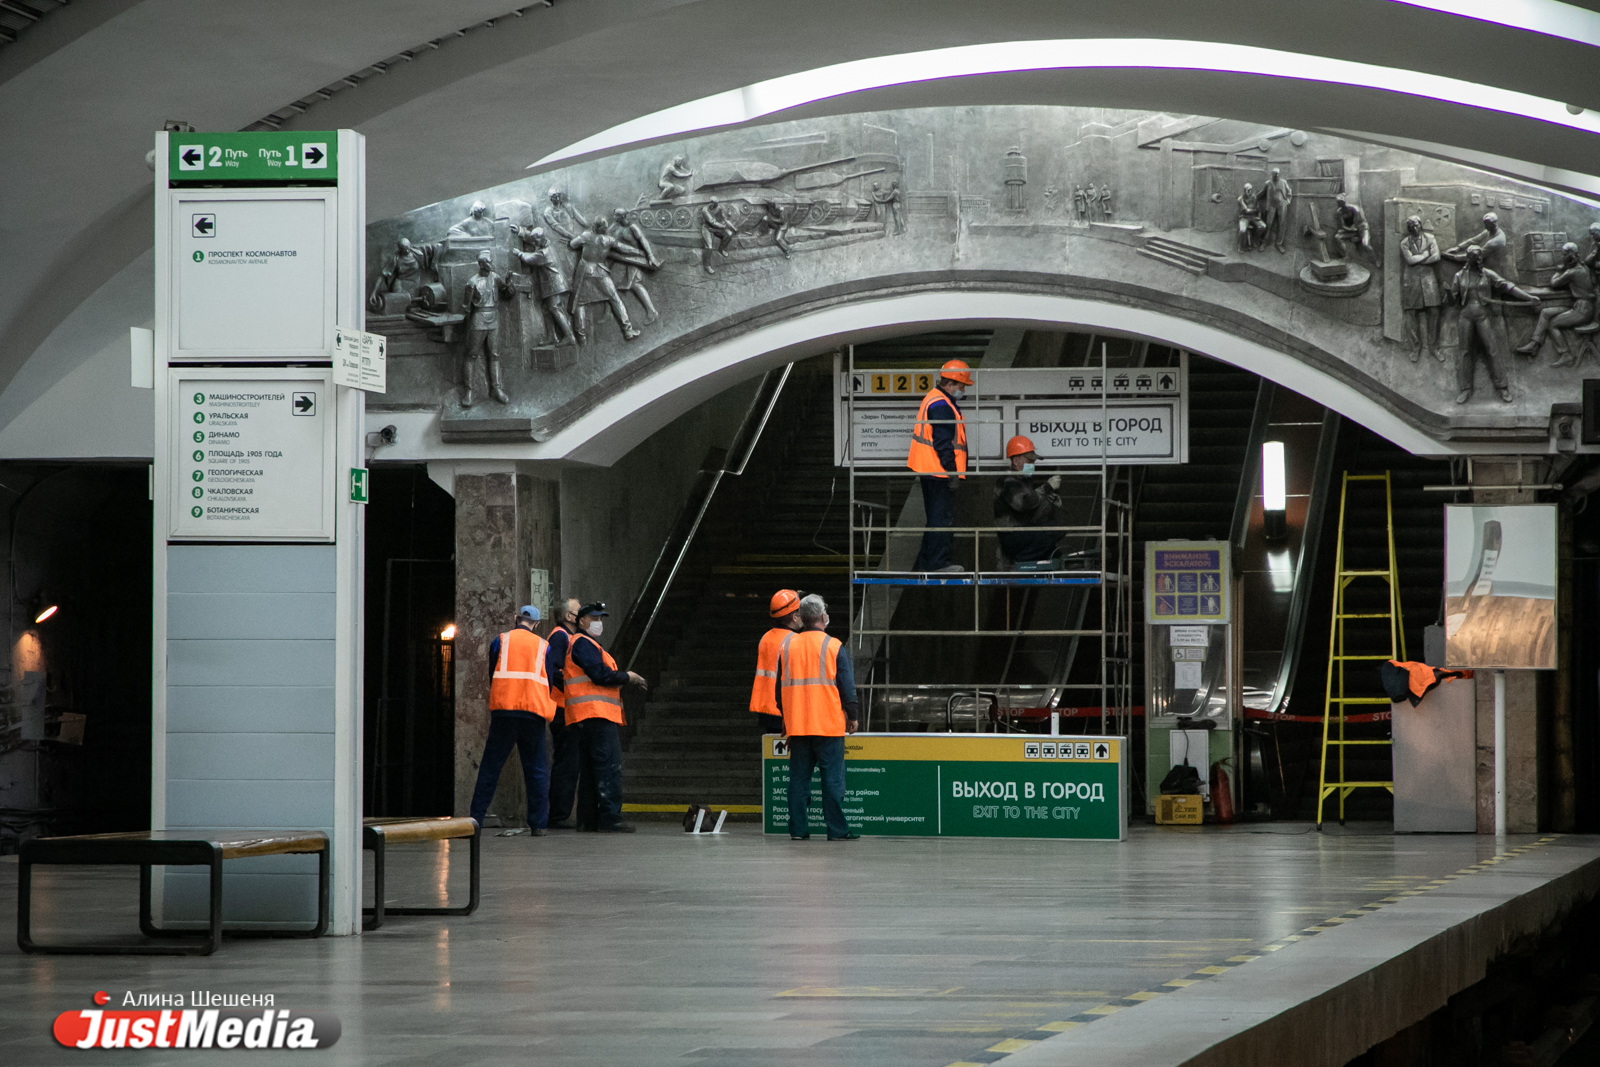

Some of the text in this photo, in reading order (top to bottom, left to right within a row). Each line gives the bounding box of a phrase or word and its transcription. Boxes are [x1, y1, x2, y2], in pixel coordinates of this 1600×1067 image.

[208, 146, 248, 167] 2 Путь
[258, 145, 299, 166] Путь 1
[225, 160, 240, 168] Way
[267, 160, 282, 168] Way
[876, 376, 886, 390] 1
[898, 376, 907, 390] 2
[919, 376, 929, 390] 3
[1030, 422, 1087, 434] ВЫХОД
[1108, 418, 1162, 433] ГОРОД
[1051, 438, 1072, 447] EXIT
[1076, 438, 1089, 447] TO
[1116, 437, 1138, 446] CITY
[1267, 712, 1295, 720] STOP
[952, 781, 1104, 802] ВЫХОД В ГОРОД
[973, 805, 1080, 819] EXIT TO THE CITY
